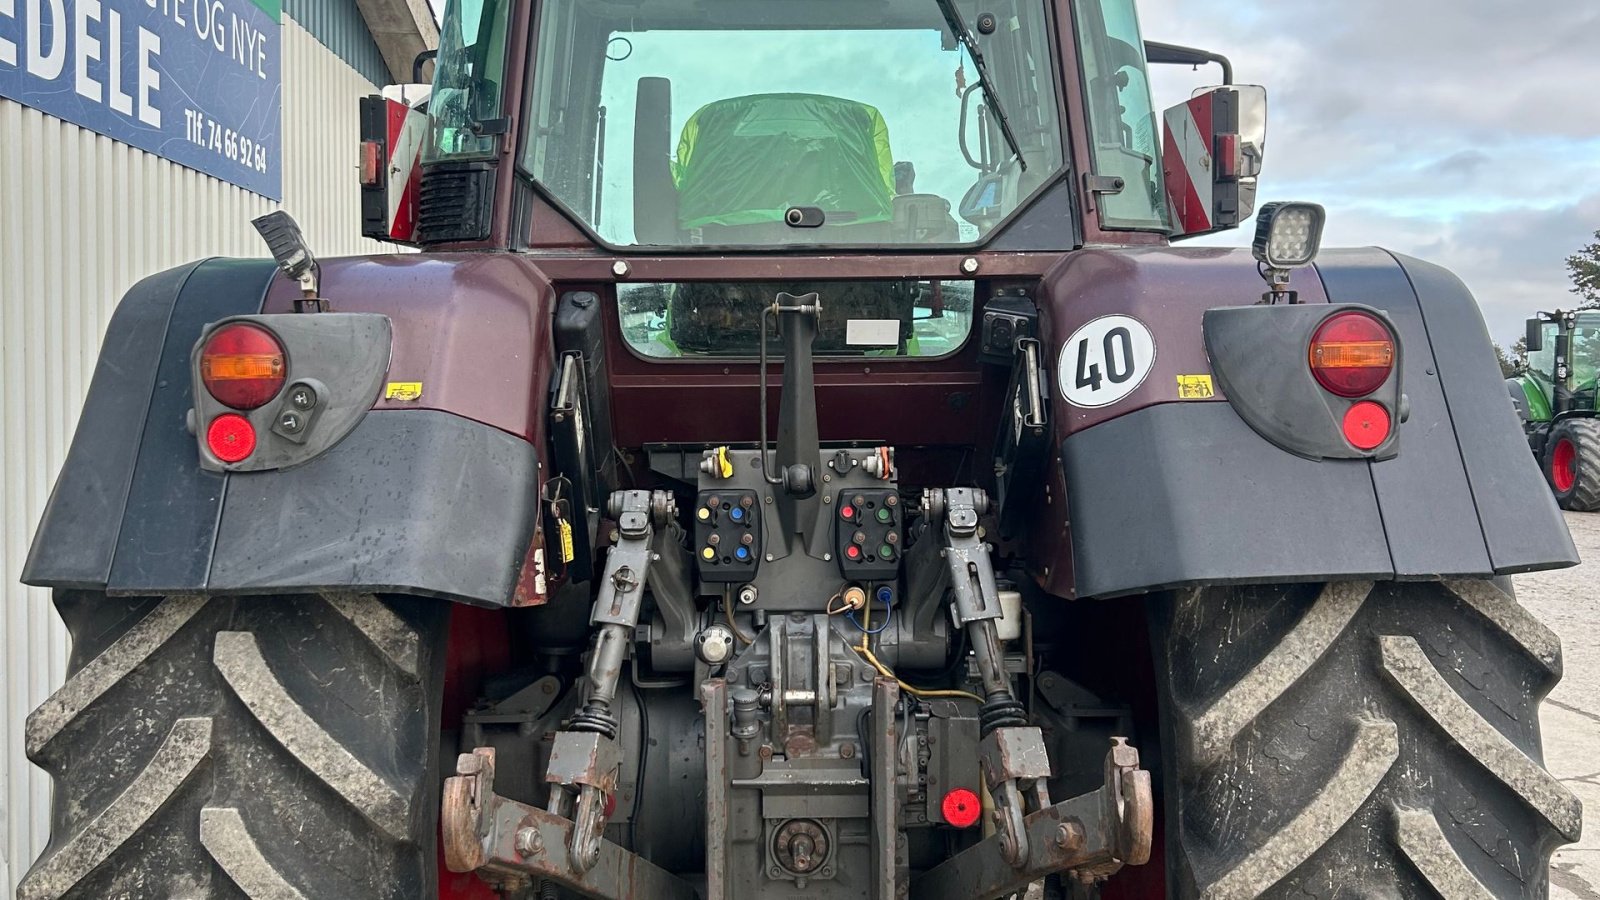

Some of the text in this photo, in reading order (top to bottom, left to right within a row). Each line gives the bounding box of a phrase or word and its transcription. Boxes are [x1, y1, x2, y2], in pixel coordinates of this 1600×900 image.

[193, 0, 225, 52] OG
[232, 12, 267, 80] NYE
[184, 108, 267, 174] Tlf. 74 66 92 64
[1075, 326, 1136, 392] 40
